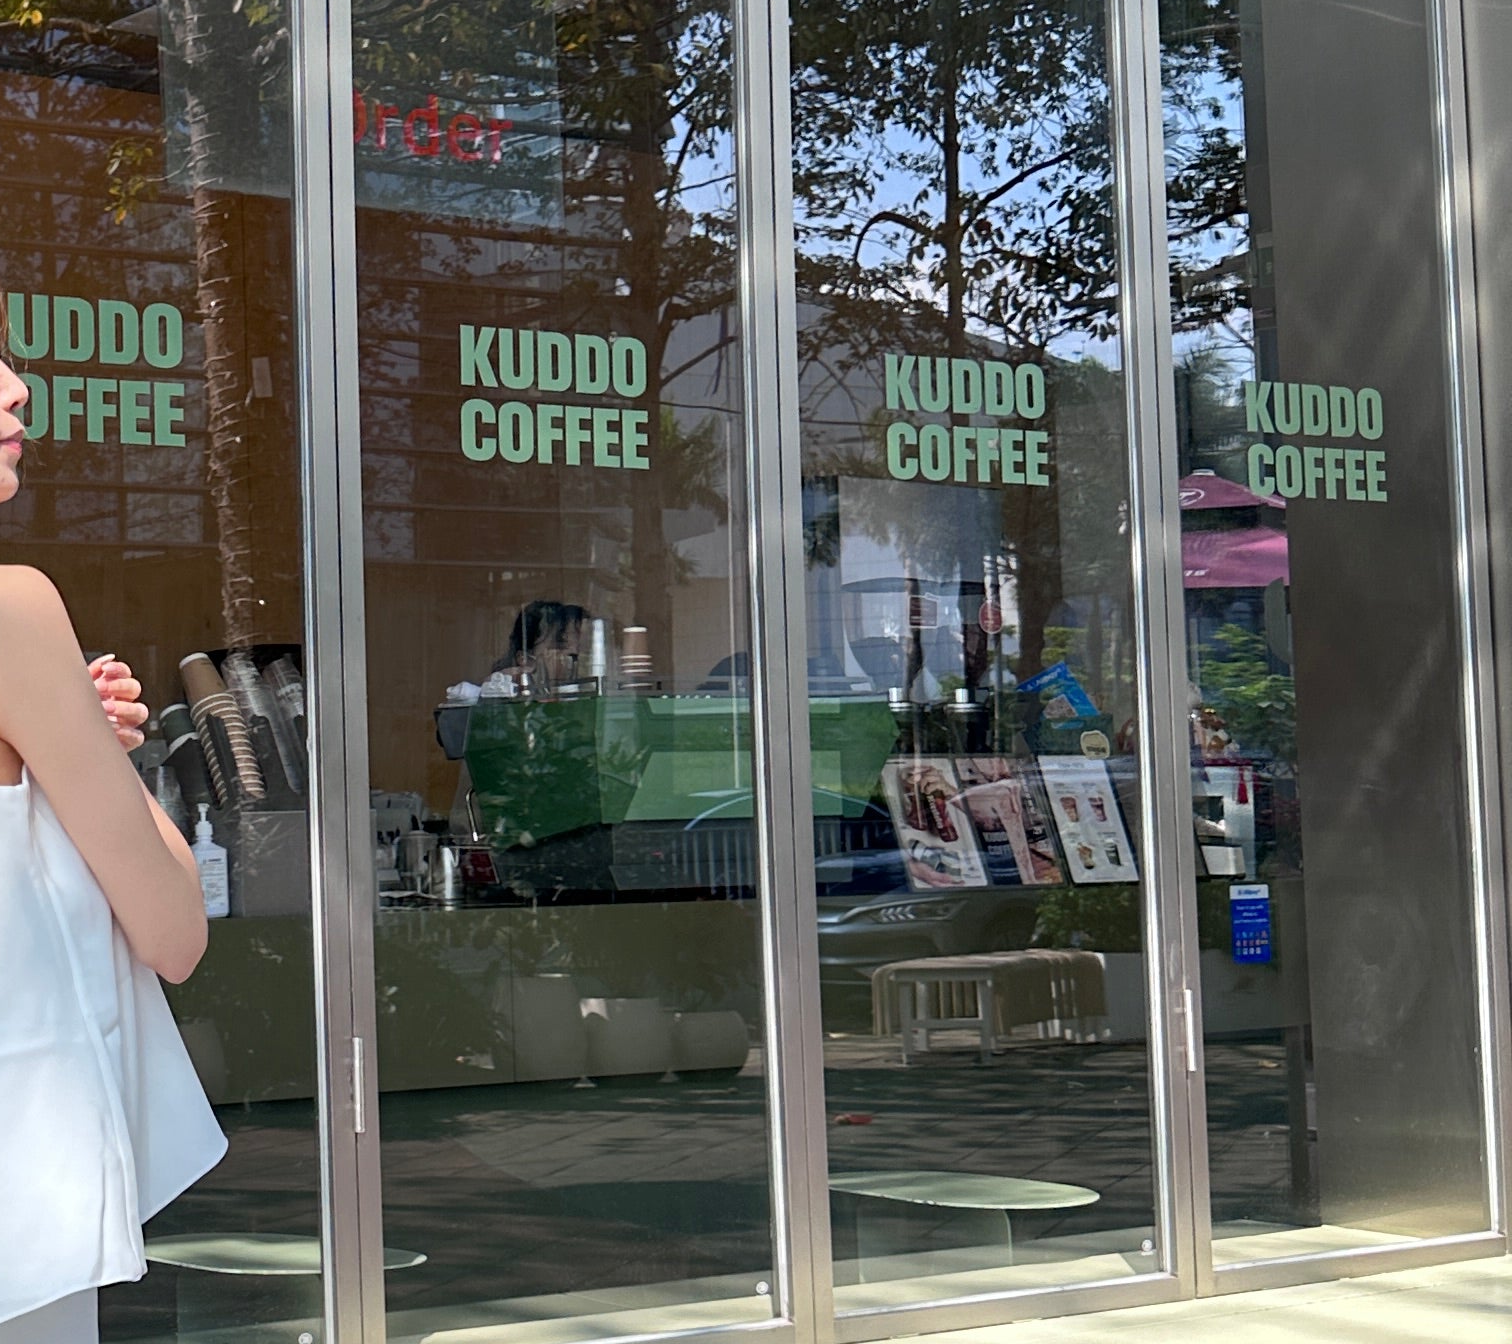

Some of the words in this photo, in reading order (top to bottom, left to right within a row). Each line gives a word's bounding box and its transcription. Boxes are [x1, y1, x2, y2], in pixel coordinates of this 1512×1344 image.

[7, 292, 183, 368] UDDO
[460, 325, 648, 397] KUDDO
[14, 372, 187, 447] OFFEE
[884, 353, 1046, 419] KUDDO
[1244, 381, 1384, 440] KUDDO
[460, 399, 650, 470] COFFEE
[887, 422, 1051, 487] COFFEE
[1247, 443, 1389, 503] COFFEE
